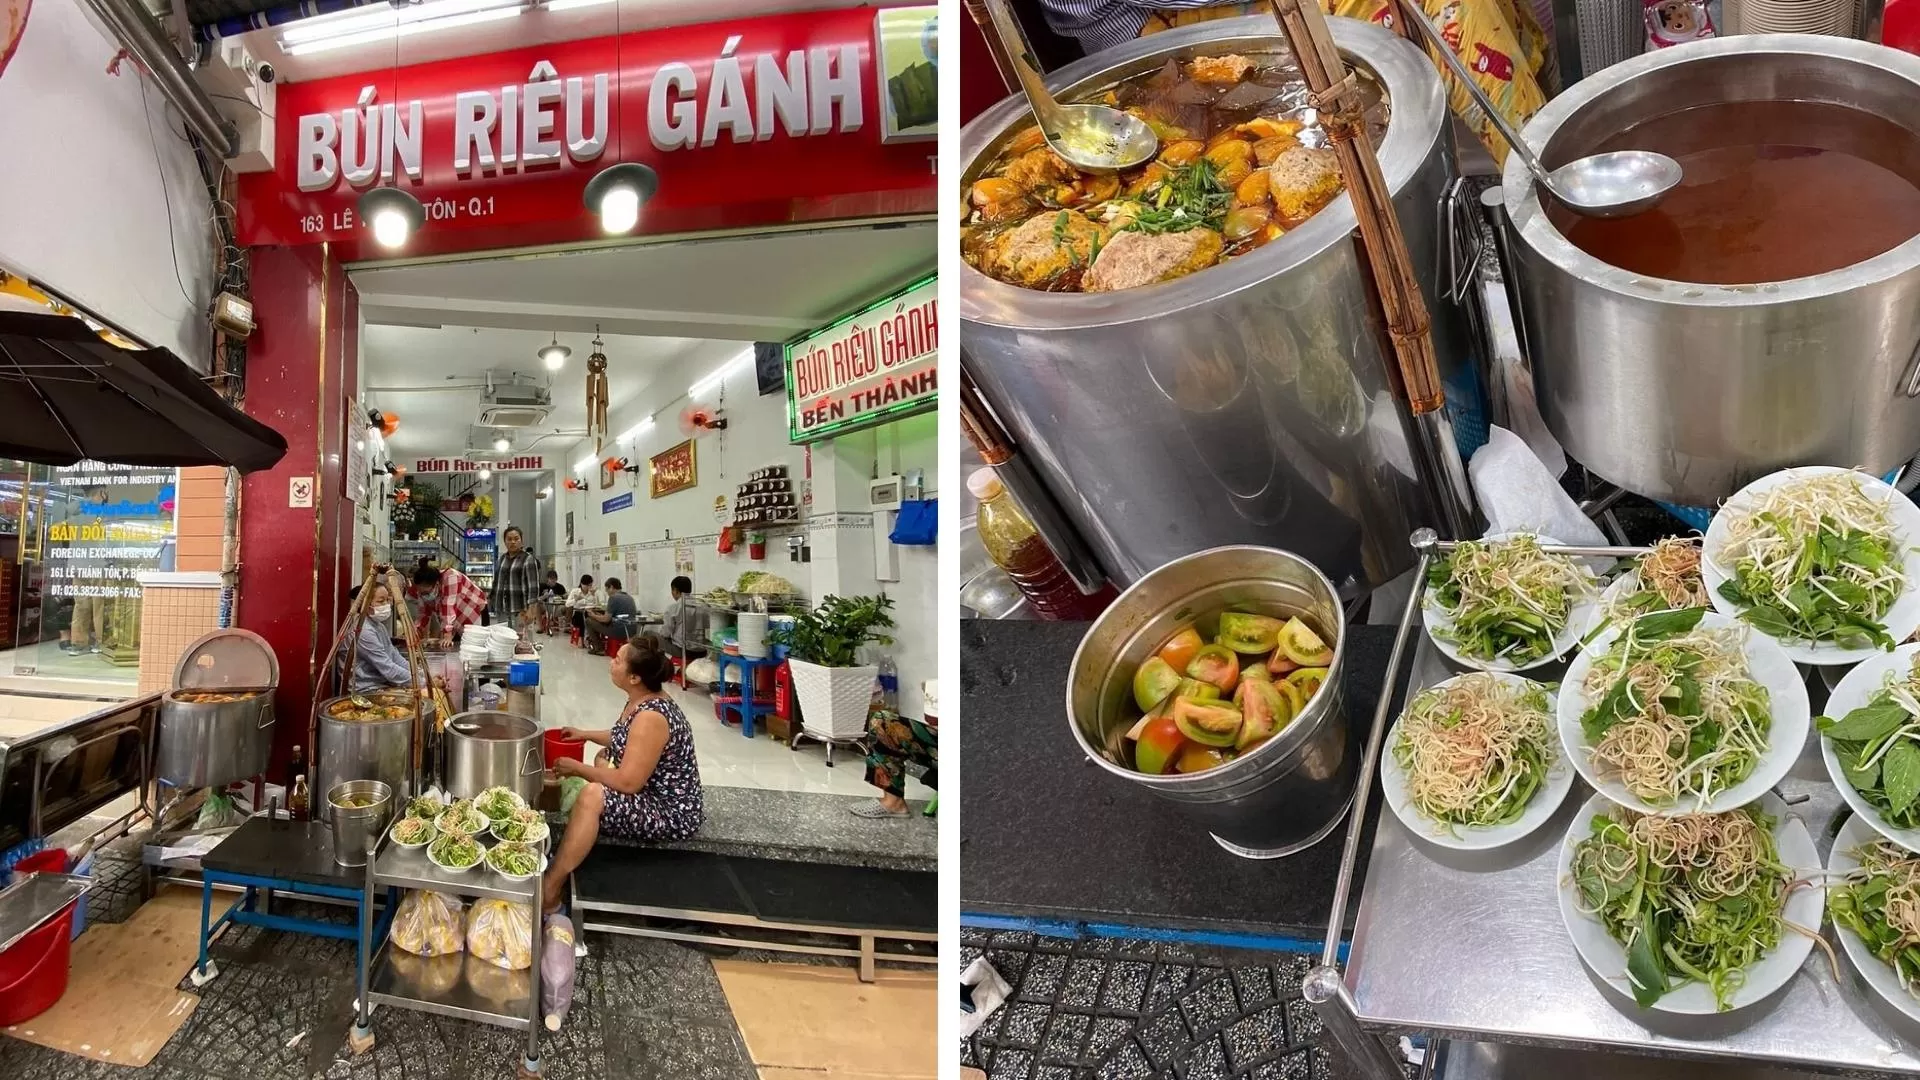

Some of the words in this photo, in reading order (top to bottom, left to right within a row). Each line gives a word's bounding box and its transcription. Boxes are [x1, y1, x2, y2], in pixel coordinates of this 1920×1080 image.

[297, 85, 424, 192] BÚN
[454, 60, 609, 181] RIÊU
[647, 35, 863, 151] GÁNH
[300, 215, 324, 233] 163
[333, 208, 353, 230] LÊ
[796, 344, 831, 399] BÚN
[832, 325, 878, 385] RIÊU
[880, 299, 938, 367] GÁNH
[802, 397, 844, 429] BẾN
[851, 368, 938, 413] THÀNH
[416, 458, 449, 472] BÚN
[60, 477, 90, 486] VIETNAM
[92, 476, 112, 485] BANK
[113, 476, 128, 485] FOR
[130, 475, 166, 485] INDUSTRY
[50, 548, 87, 558] FOREIGN
[50, 567, 64, 578] 161
[66, 565, 75, 578] LÊ
[64, 585, 119, 597] 028.3822.3066
